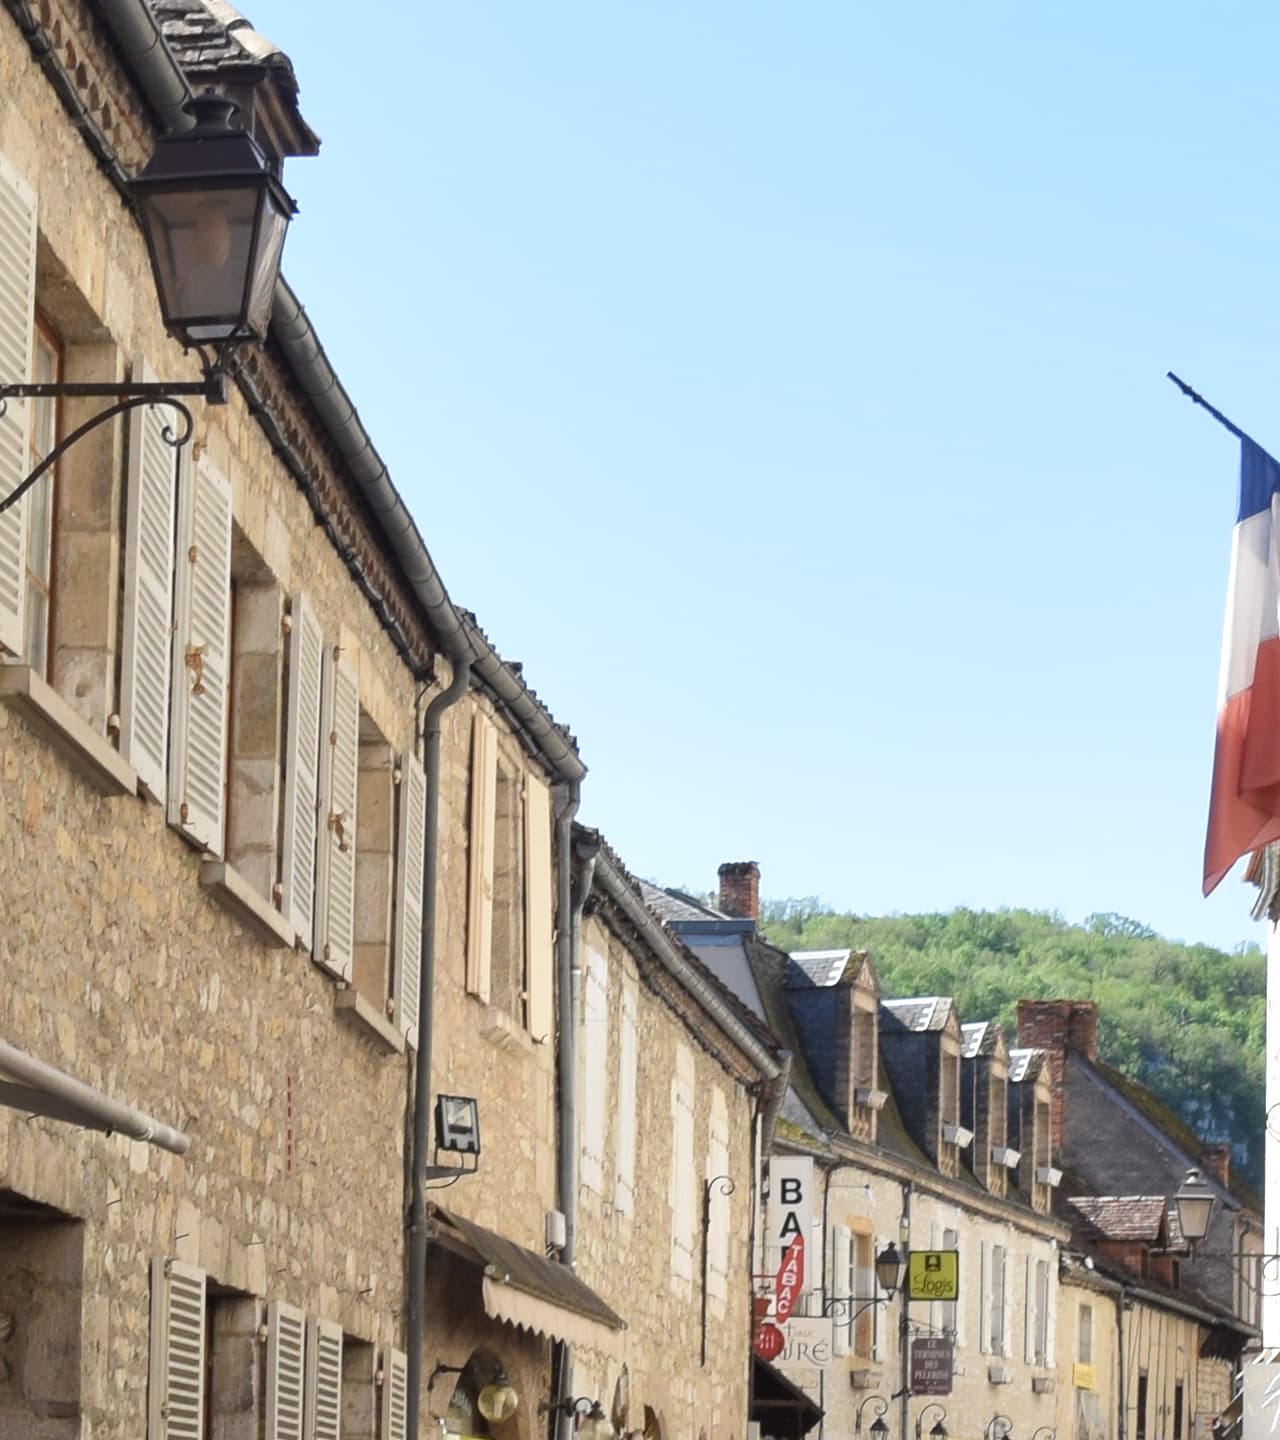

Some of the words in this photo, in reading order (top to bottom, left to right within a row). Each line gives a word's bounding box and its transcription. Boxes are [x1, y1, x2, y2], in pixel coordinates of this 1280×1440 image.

[779, 1177, 804, 1258] BA
[777, 1244, 803, 1314] TABAC
[913, 1271, 954, 1297] Logis
